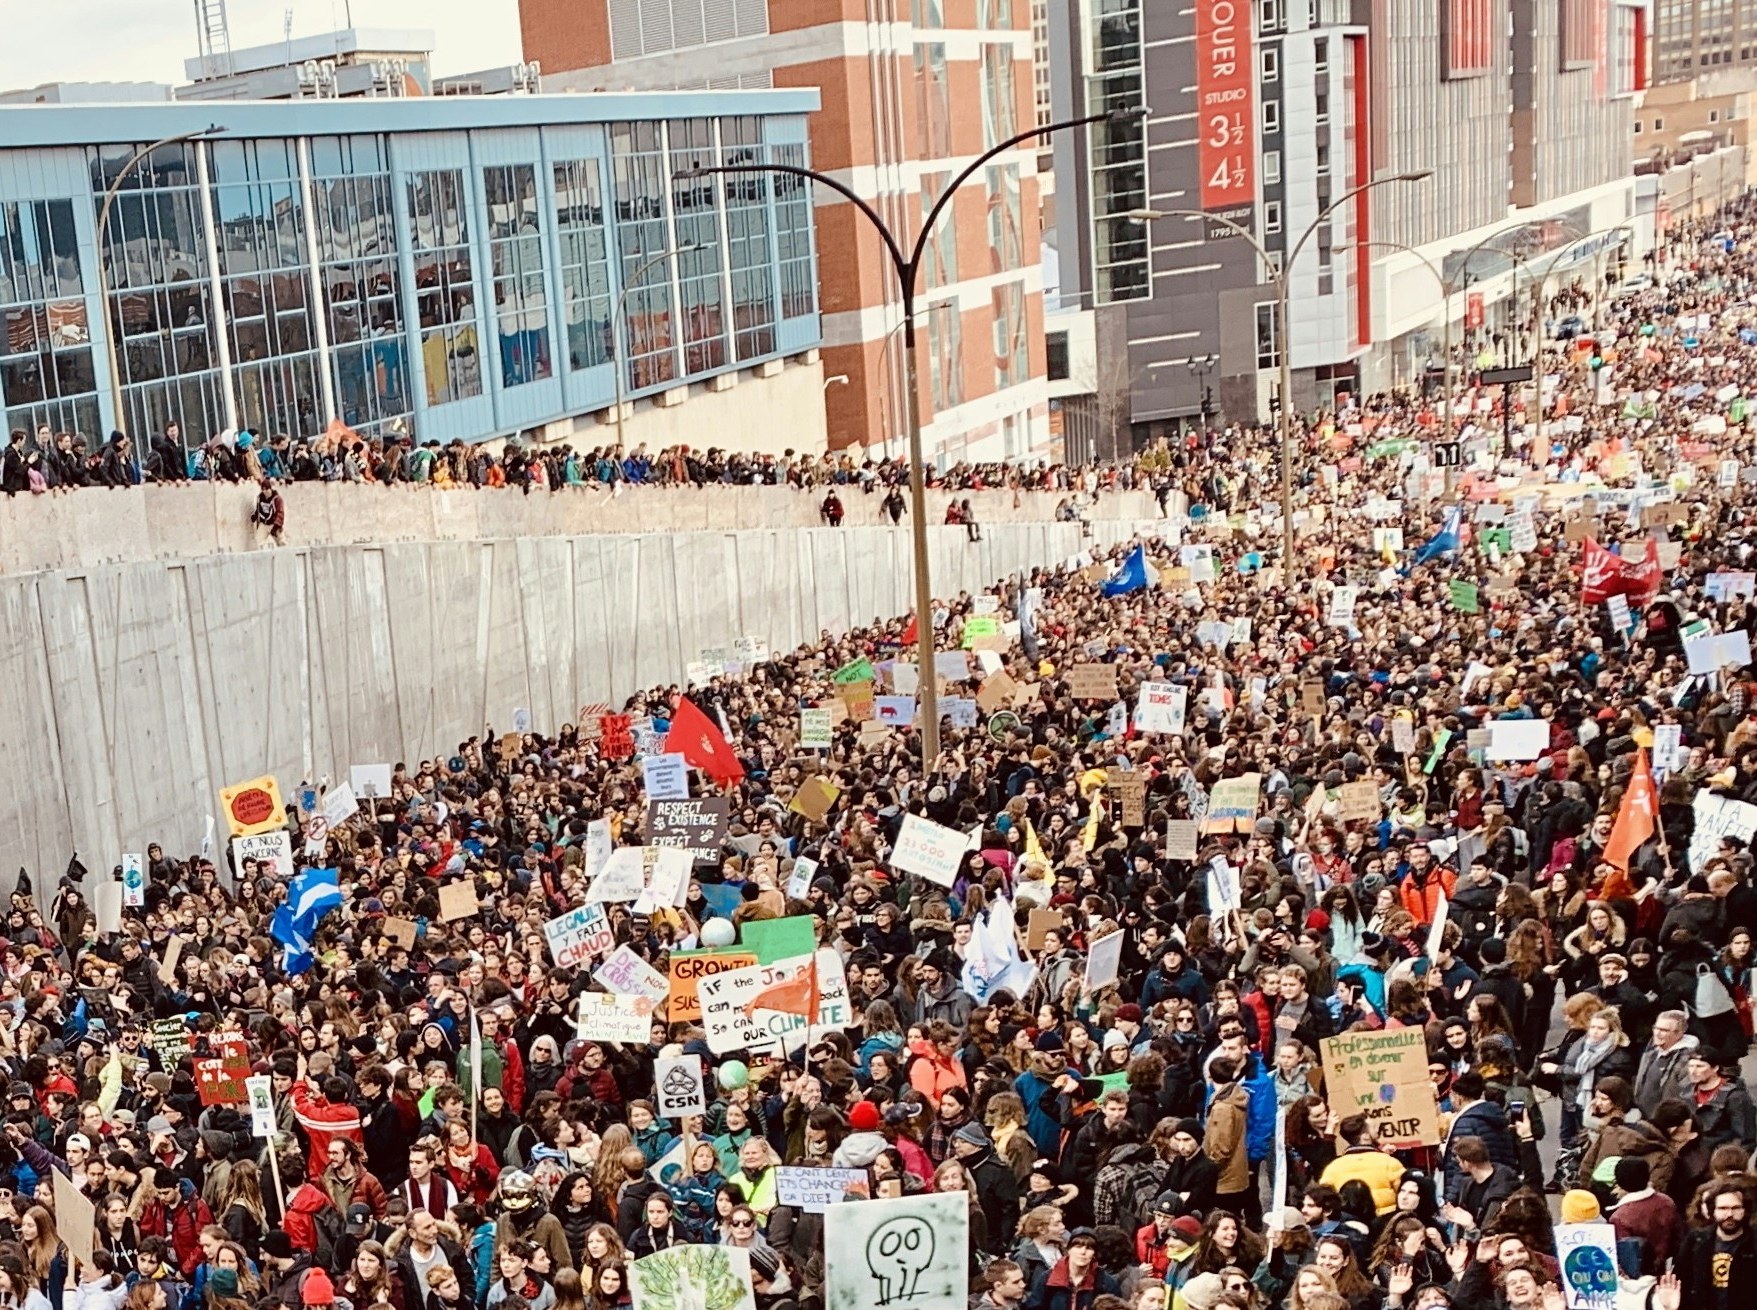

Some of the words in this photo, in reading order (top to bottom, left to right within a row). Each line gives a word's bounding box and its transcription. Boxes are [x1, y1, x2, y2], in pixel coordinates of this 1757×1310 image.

[1205, 88, 1246, 105] STUDIO
[845, 671, 863, 683] NOT
[657, 801, 703, 816] RESPECT
[1719, 798, 1742, 820] LA
[669, 813, 719, 827] EXISTENCE
[241, 836, 253, 849] ÇA
[259, 835, 283, 846] NOUS
[652, 835, 692, 848] EXPECT
[577, 919, 604, 940] FAIT
[557, 930, 612, 967] CHAUD
[644, 976, 668, 990] NOW
[733, 977, 755, 989] the
[588, 1001, 638, 1019] Justice
[708, 1001, 730, 1014] can
[733, 1016, 754, 1029] CAN
[743, 1027, 769, 1042] OUR
[224, 1043, 238, 1058] le
[218, 1069, 231, 1083] la
[1367, 1069, 1387, 1083] sur
[664, 1095, 700, 1109] CSN
[1355, 1092, 1376, 1106] une
[1364, 1105, 1394, 1119] sans
[798, 1178, 850, 1192] CHANGE
[802, 1192, 831, 1204] DIE!
